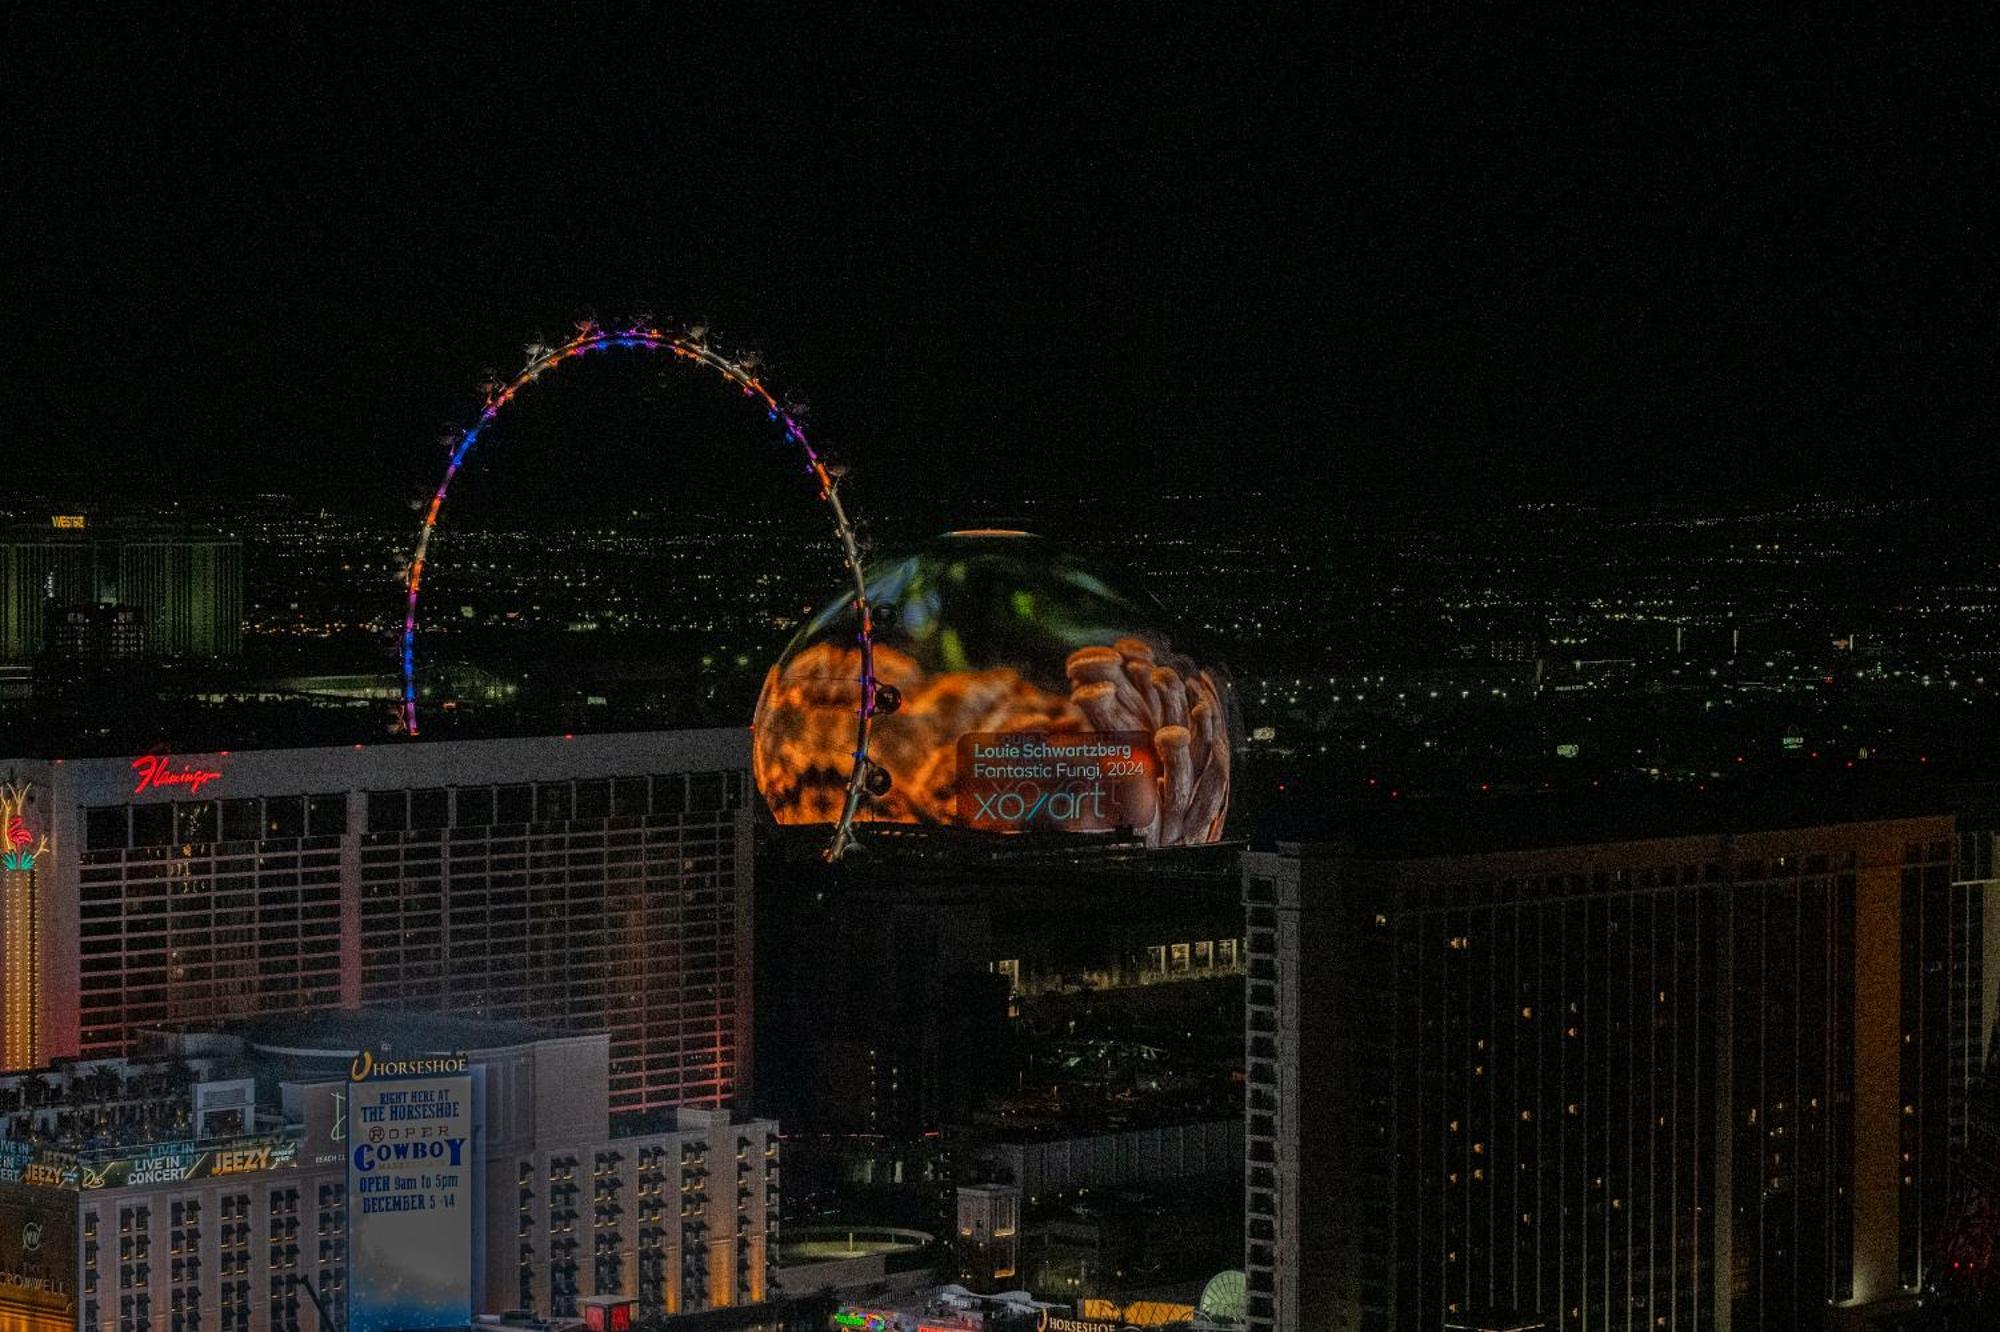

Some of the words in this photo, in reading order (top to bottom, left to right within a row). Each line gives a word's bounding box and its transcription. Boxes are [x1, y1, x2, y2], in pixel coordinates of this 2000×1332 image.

[974, 743, 1020, 759] Louie
[1022, 743, 1132, 760] Schwartzberg
[131, 754, 222, 794] Flamingo
[974, 763, 1051, 778] Fantastic
[1056, 763, 1103, 781] Fungi,
[1107, 761, 1145, 777] 2024
[373, 1059, 468, 1077] HORSESHOE
[380, 1091, 408, 1105] RIGHT
[411, 1090, 436, 1104] HERE
[438, 1088, 451, 1101] AT
[361, 1106, 385, 1123] THE
[390, 1102, 460, 1121] HORSESHOE
[135, 1156, 163, 1172] LIVE
[166, 1155, 180, 1169] IN
[211, 1146, 271, 1176] JEEZY
[354, 1138, 466, 1172] COWBOY
[128, 1167, 187, 1186] CONCERT
[435, 1173, 459, 1191] 5pm
[363, 1194, 426, 1214] DECEMBER
